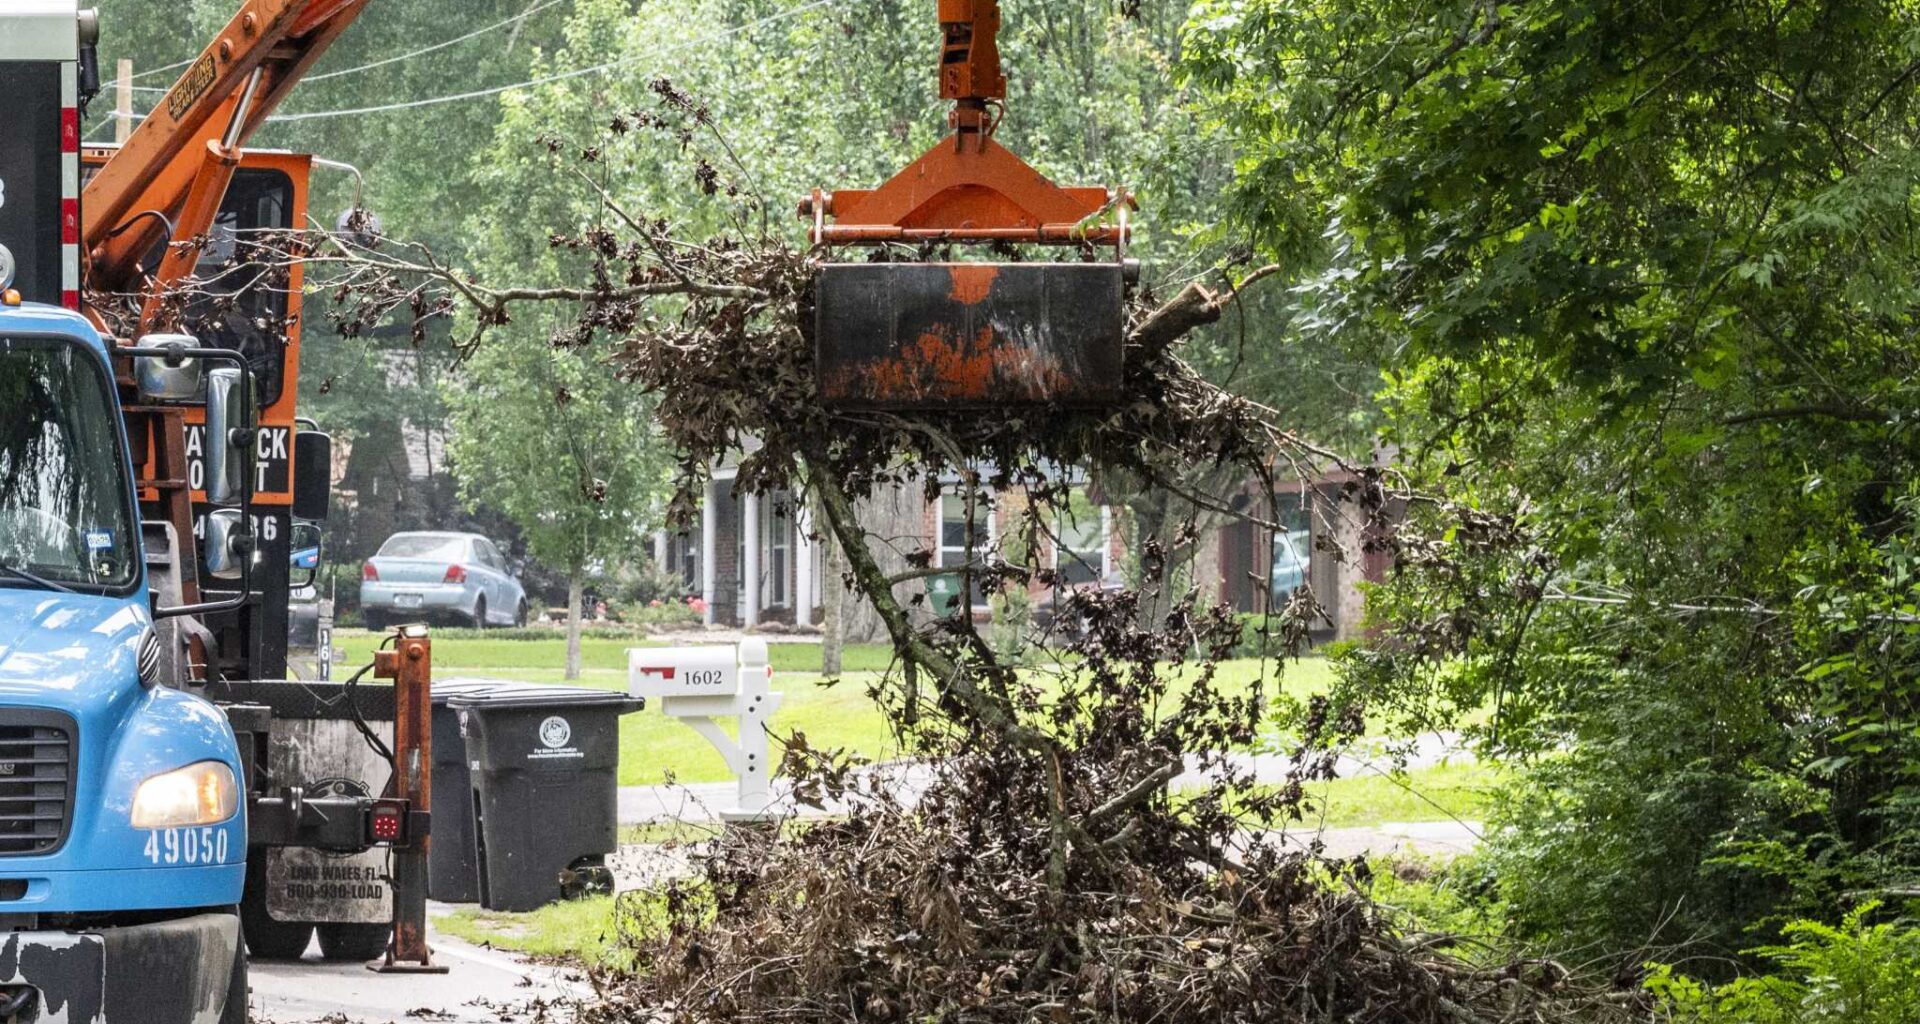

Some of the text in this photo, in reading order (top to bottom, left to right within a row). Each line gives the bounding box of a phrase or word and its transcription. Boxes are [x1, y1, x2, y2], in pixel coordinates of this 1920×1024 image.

[168, 51, 213, 112] LIGHTING
[257, 428, 287, 459] CK
[321, 630, 329, 680] 161
[684, 670, 722, 685] 1602
[144, 828, 228, 864] 49050
